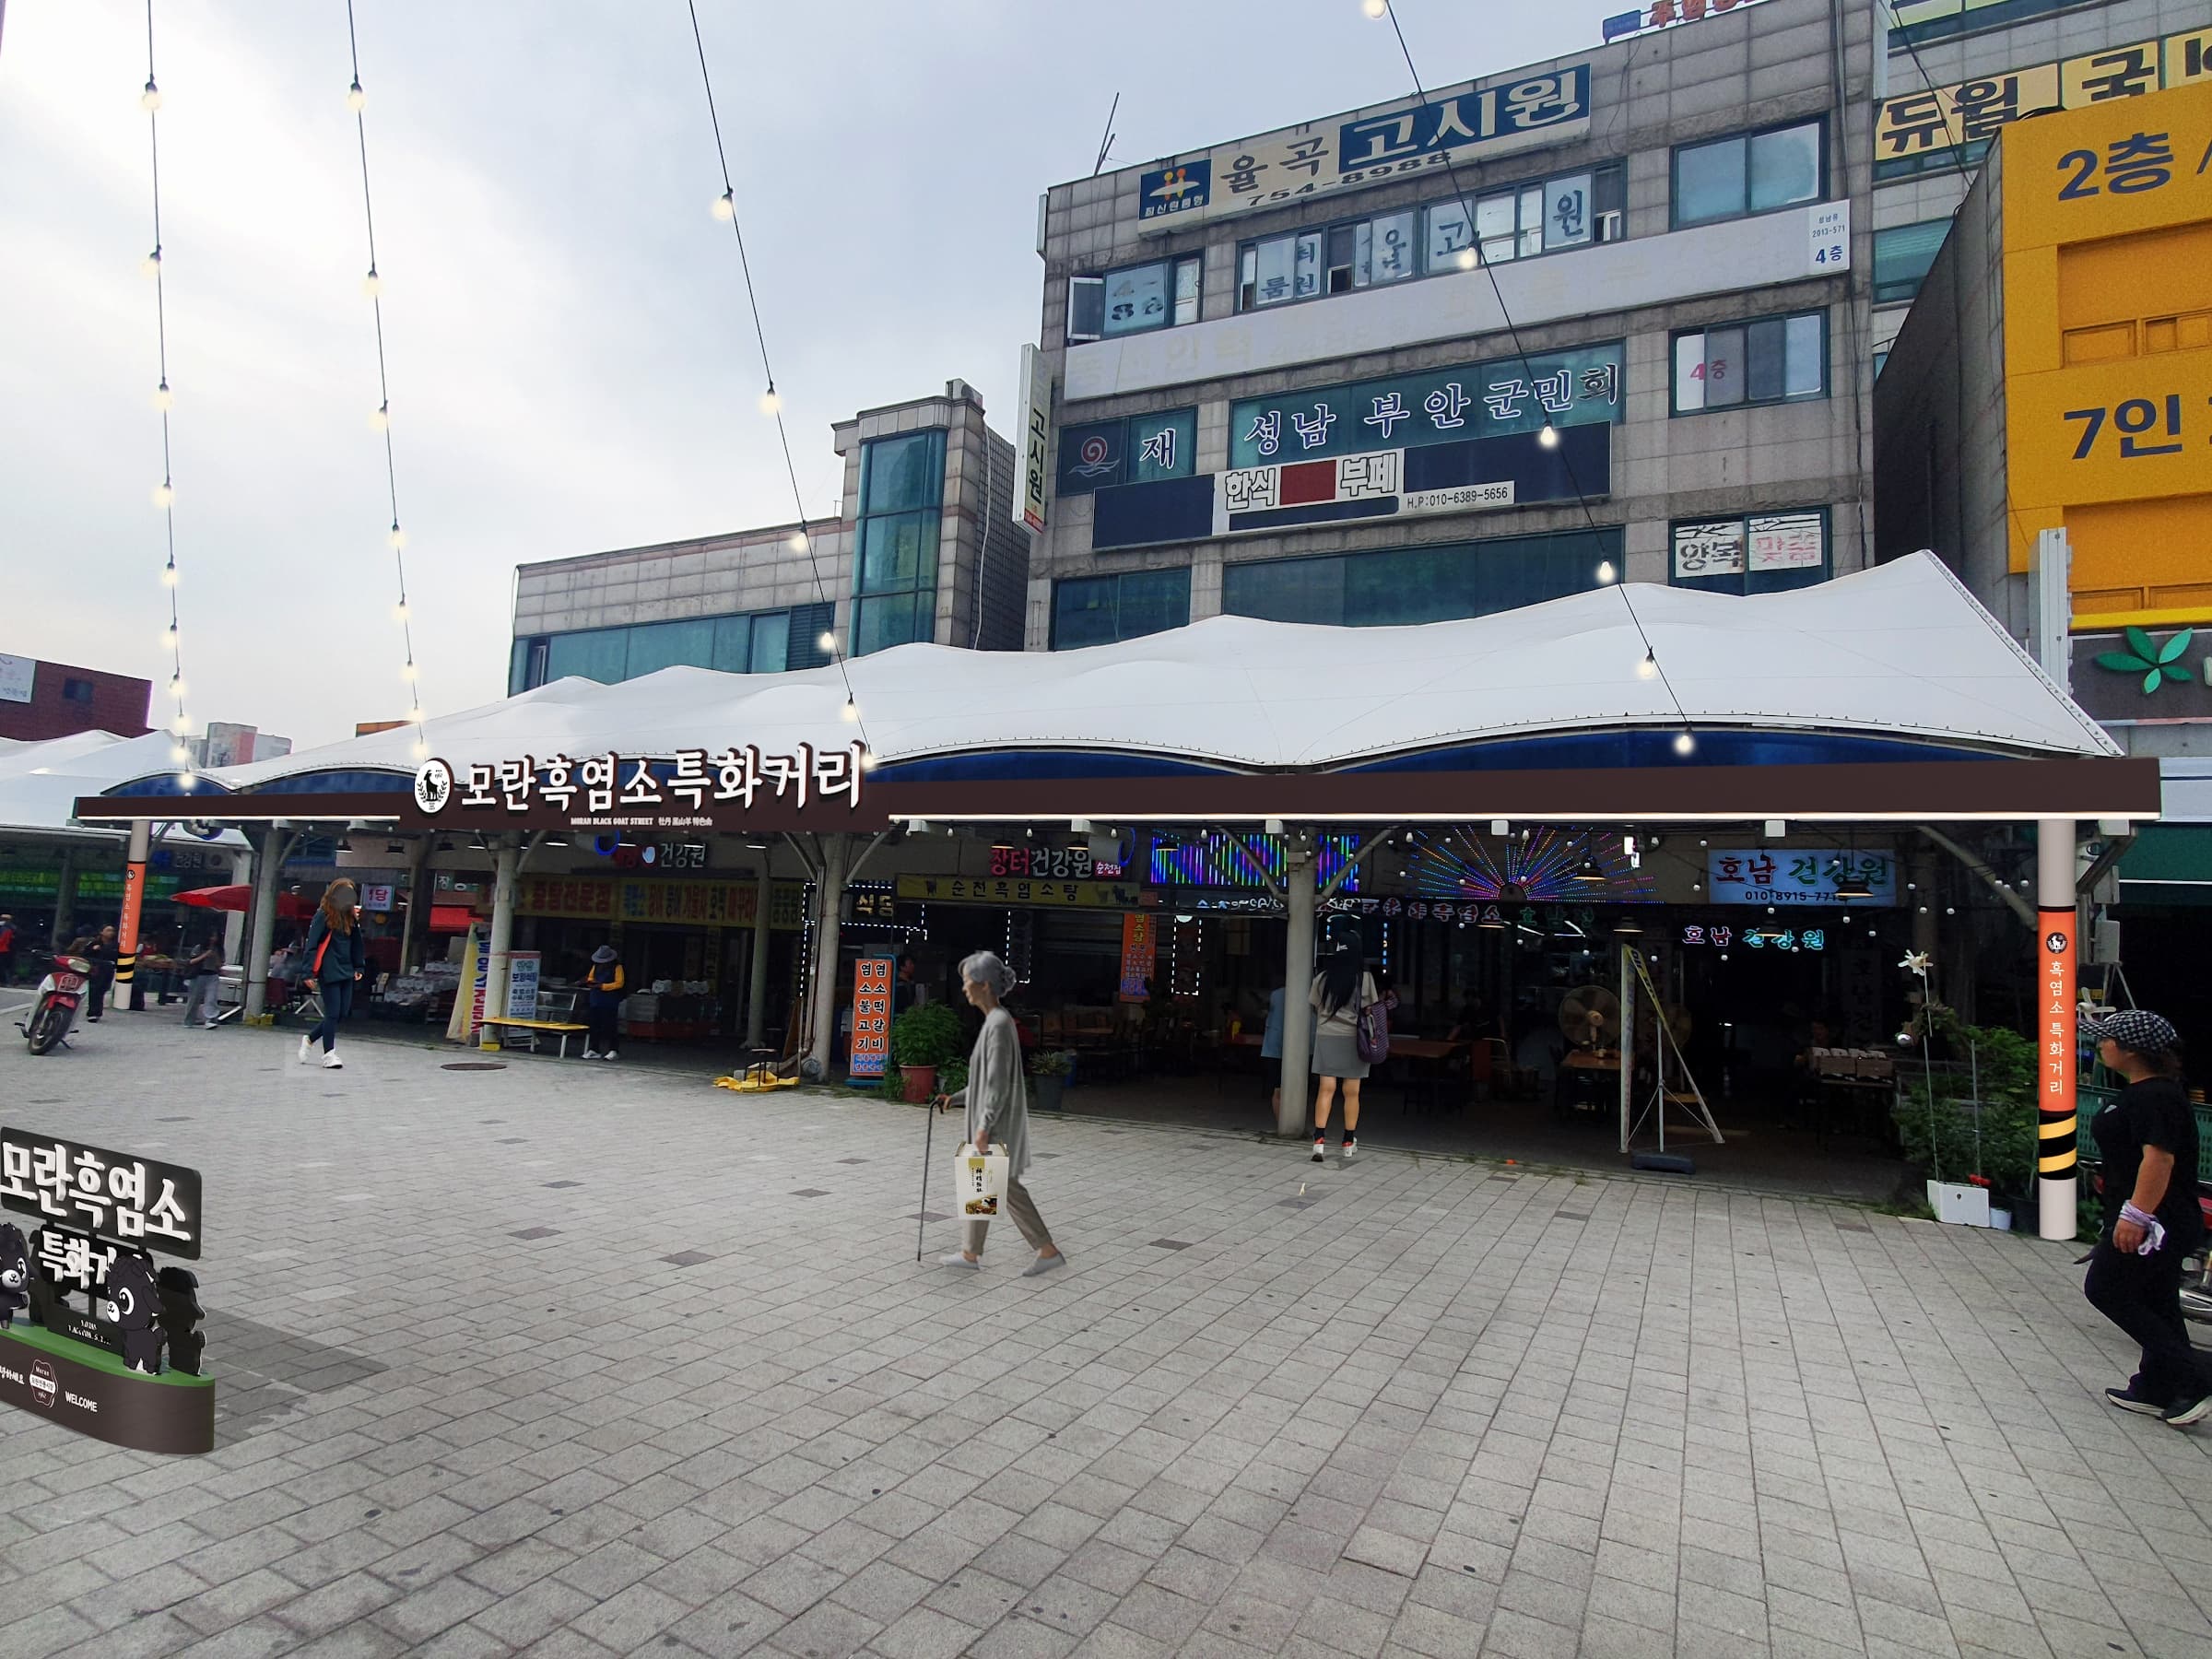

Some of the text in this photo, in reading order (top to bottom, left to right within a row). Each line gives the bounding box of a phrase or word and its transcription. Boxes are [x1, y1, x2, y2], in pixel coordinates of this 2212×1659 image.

[1220, 71, 1581, 194] 율곡 고시원
[2056, 132, 2174, 201] 2층
[1247, 151, 1453, 207] 754-8988
[1816, 244, 1842, 264] 4층
[1689, 358, 1727, 382] 4층
[1030, 406, 1047, 505] 고시원
[1244, 403, 1336, 455] 성남
[2063, 393, 2183, 461] 7인
[1225, 466, 1277, 512] 한식
[461, 737, 868, 814] 모란흑염소특화거리
[593, 817, 613, 826] BLACK
[613, 817, 629, 826] GOAT
[630, 817, 654, 826] STREET
[1715, 853, 1889, 886] 호남 건강원
[855, 961, 873, 1053] 염소불고기
[870, 961, 888, 1053] 염소떡갈비
[2049, 960, 2065, 1096] 흑염소 특화거리
[0, 1140, 192, 1241] 모란흑염소
[65, 1390, 98, 1413] WELCOME
